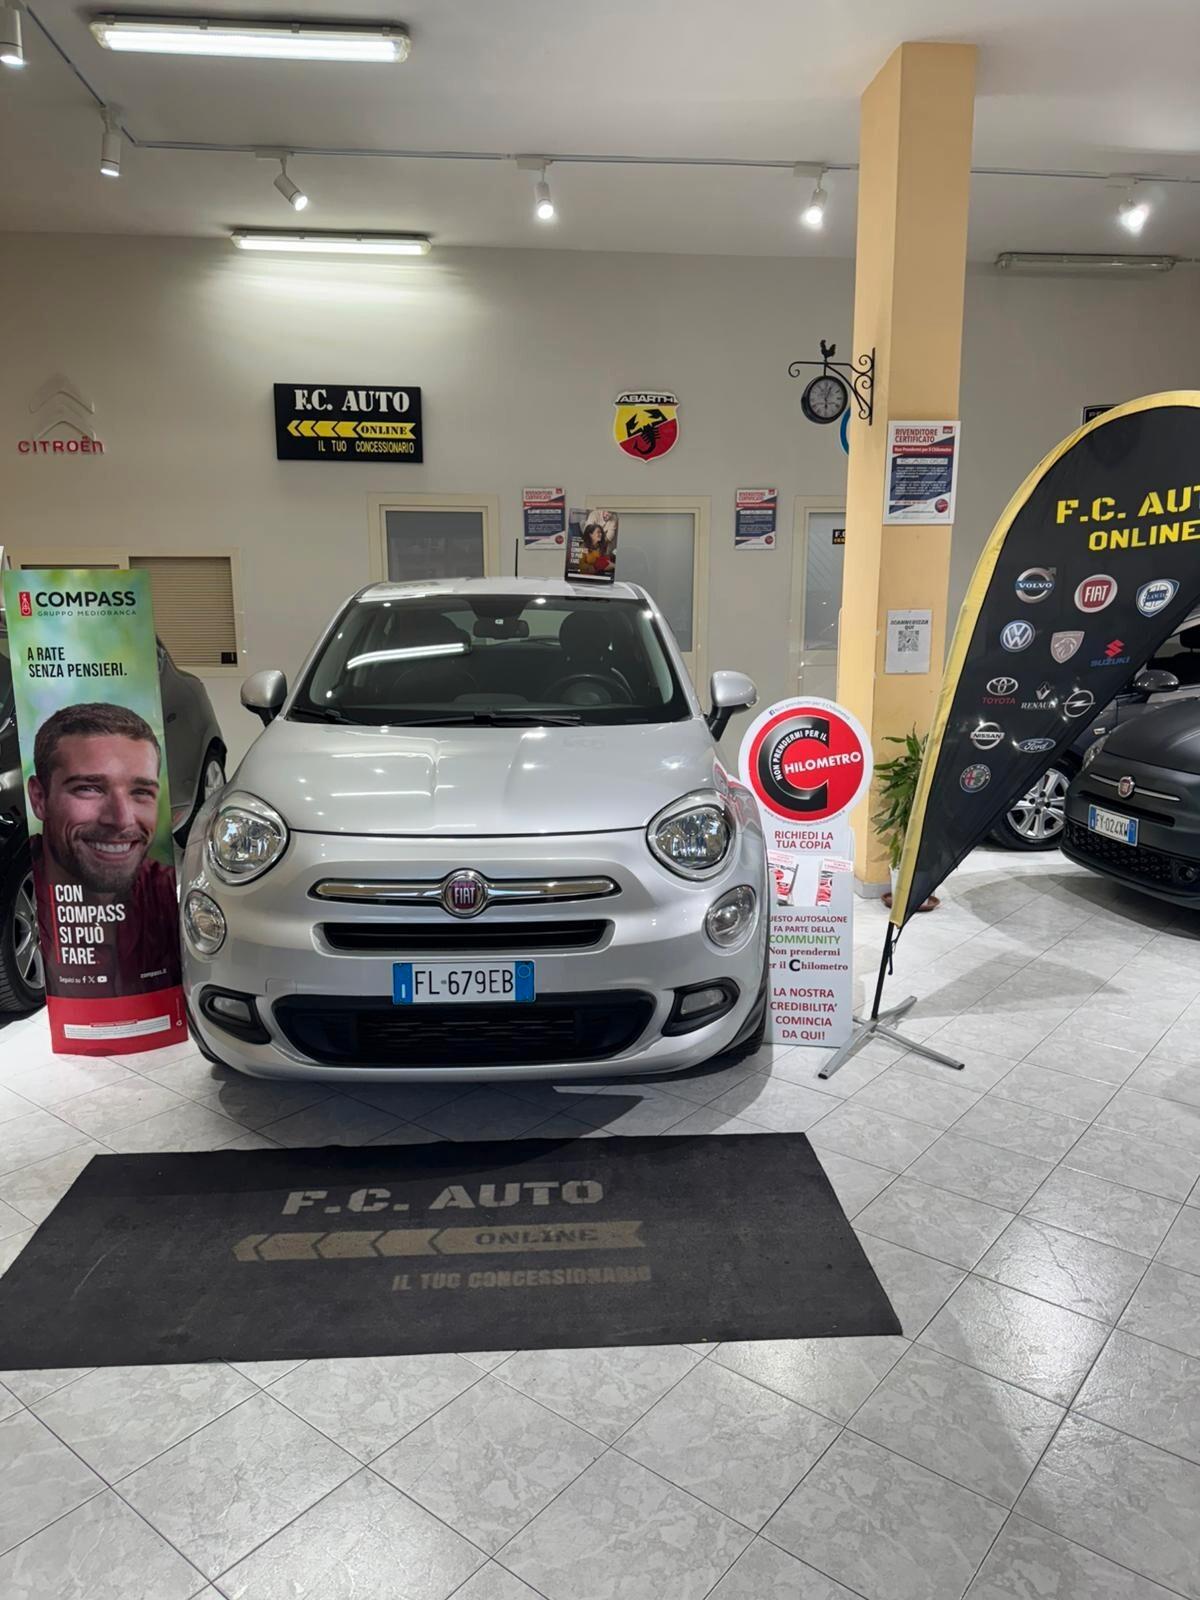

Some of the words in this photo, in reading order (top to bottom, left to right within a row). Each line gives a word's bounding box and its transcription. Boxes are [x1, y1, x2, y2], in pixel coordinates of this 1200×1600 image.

[293, 389, 333, 411] F.C.
[341, 390, 410, 413] AUTO
[620, 395, 674, 403] ABARTH
[360, 425, 408, 435] ONLINE
[318, 440, 326, 452] IL
[331, 440, 347, 452] TUO
[355, 441, 415, 454] CONCESSIONARIO
[1056, 497, 1126, 524] F.C.
[1137, 485, 1200, 517] AU
[1088, 519, 1200, 551] ONLINE
[35, 590, 137, 608] COMPASS
[1084, 585, 1109, 602] FIAT
[27, 647, 34, 660] A
[37, 647, 65, 660] RATE
[1090, 656, 1131, 667] SUZUKI
[28, 663, 64, 677] SENZA
[67, 662, 127, 677] PENSIERI.
[805, 730, 819, 738] PER
[820, 733, 828, 741] IL
[773, 730, 804, 763] PRENDERMI
[1023, 741, 1048, 750] Ford
[773, 764, 783, 781] NON
[774, 831, 818, 840] RICHIEDI
[821, 832, 833, 840] LA
[776, 840, 796, 848] TUA
[799, 840, 831, 849] COPIA
[55, 884, 83, 902] CON
[454, 887, 476, 904] FIAT
[57, 904, 126, 923] COMPASS
[59, 927, 73, 944] SI
[75, 922, 104, 944] PUÒ
[768, 934, 841, 944] COMMUNITY
[790, 947, 840, 957] prendermi
[779, 961, 786, 969] il
[788, 958, 848, 972] Chilometro
[773, 988, 787, 997] LA
[789, 988, 835, 998] NOSTRA
[775, 1016, 832, 1026] COMINCIA
[782, 1030, 798, 1039] DA
[800, 1031, 825, 1040] QUI!
[281, 1187, 410, 1215] F.C.
[428, 1180, 604, 1210] AUTO
[475, 1228, 599, 1246] ONLINE
[390, 1274, 412, 1292] IL
[467, 1264, 651, 1289] CONCESSIONARIO
